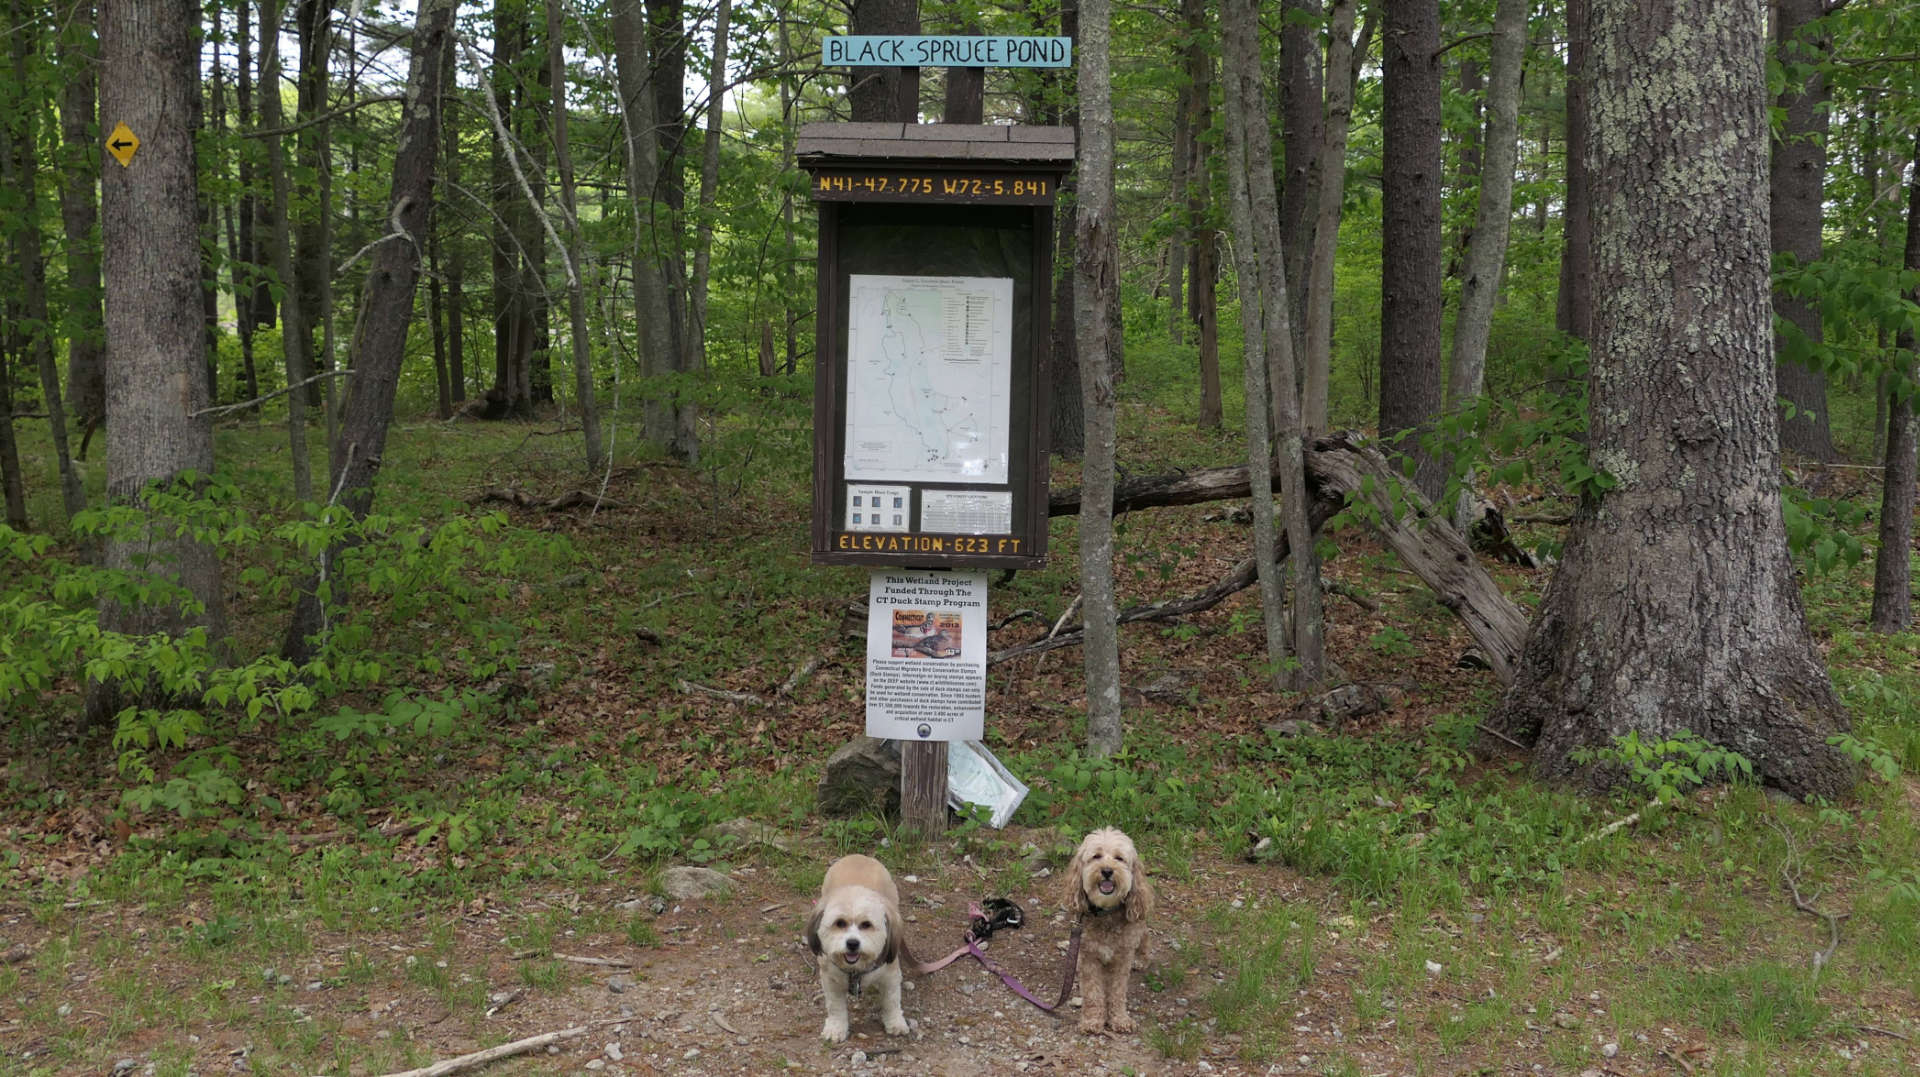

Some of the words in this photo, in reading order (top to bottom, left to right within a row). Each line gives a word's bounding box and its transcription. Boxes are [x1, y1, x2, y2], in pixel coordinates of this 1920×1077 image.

[830, 39, 905, 63] BLACK
[917, 39, 1000, 63] SPRUCE
[1007, 38, 1065, 64] POND
[819, 176, 933, 194] N41-47.775
[943, 178, 1047, 196] W72-5.841
[998, 538, 1021, 553] FT
[886, 576, 904, 584] This
[905, 577, 940, 585] Wetland
[942, 578, 972, 587] Project
[885, 586, 916, 594] Funded
[918, 588, 954, 597] Through
[956, 588, 972, 596] The
[914, 598, 941, 607] Stamp
[943, 599, 980, 608] Program
